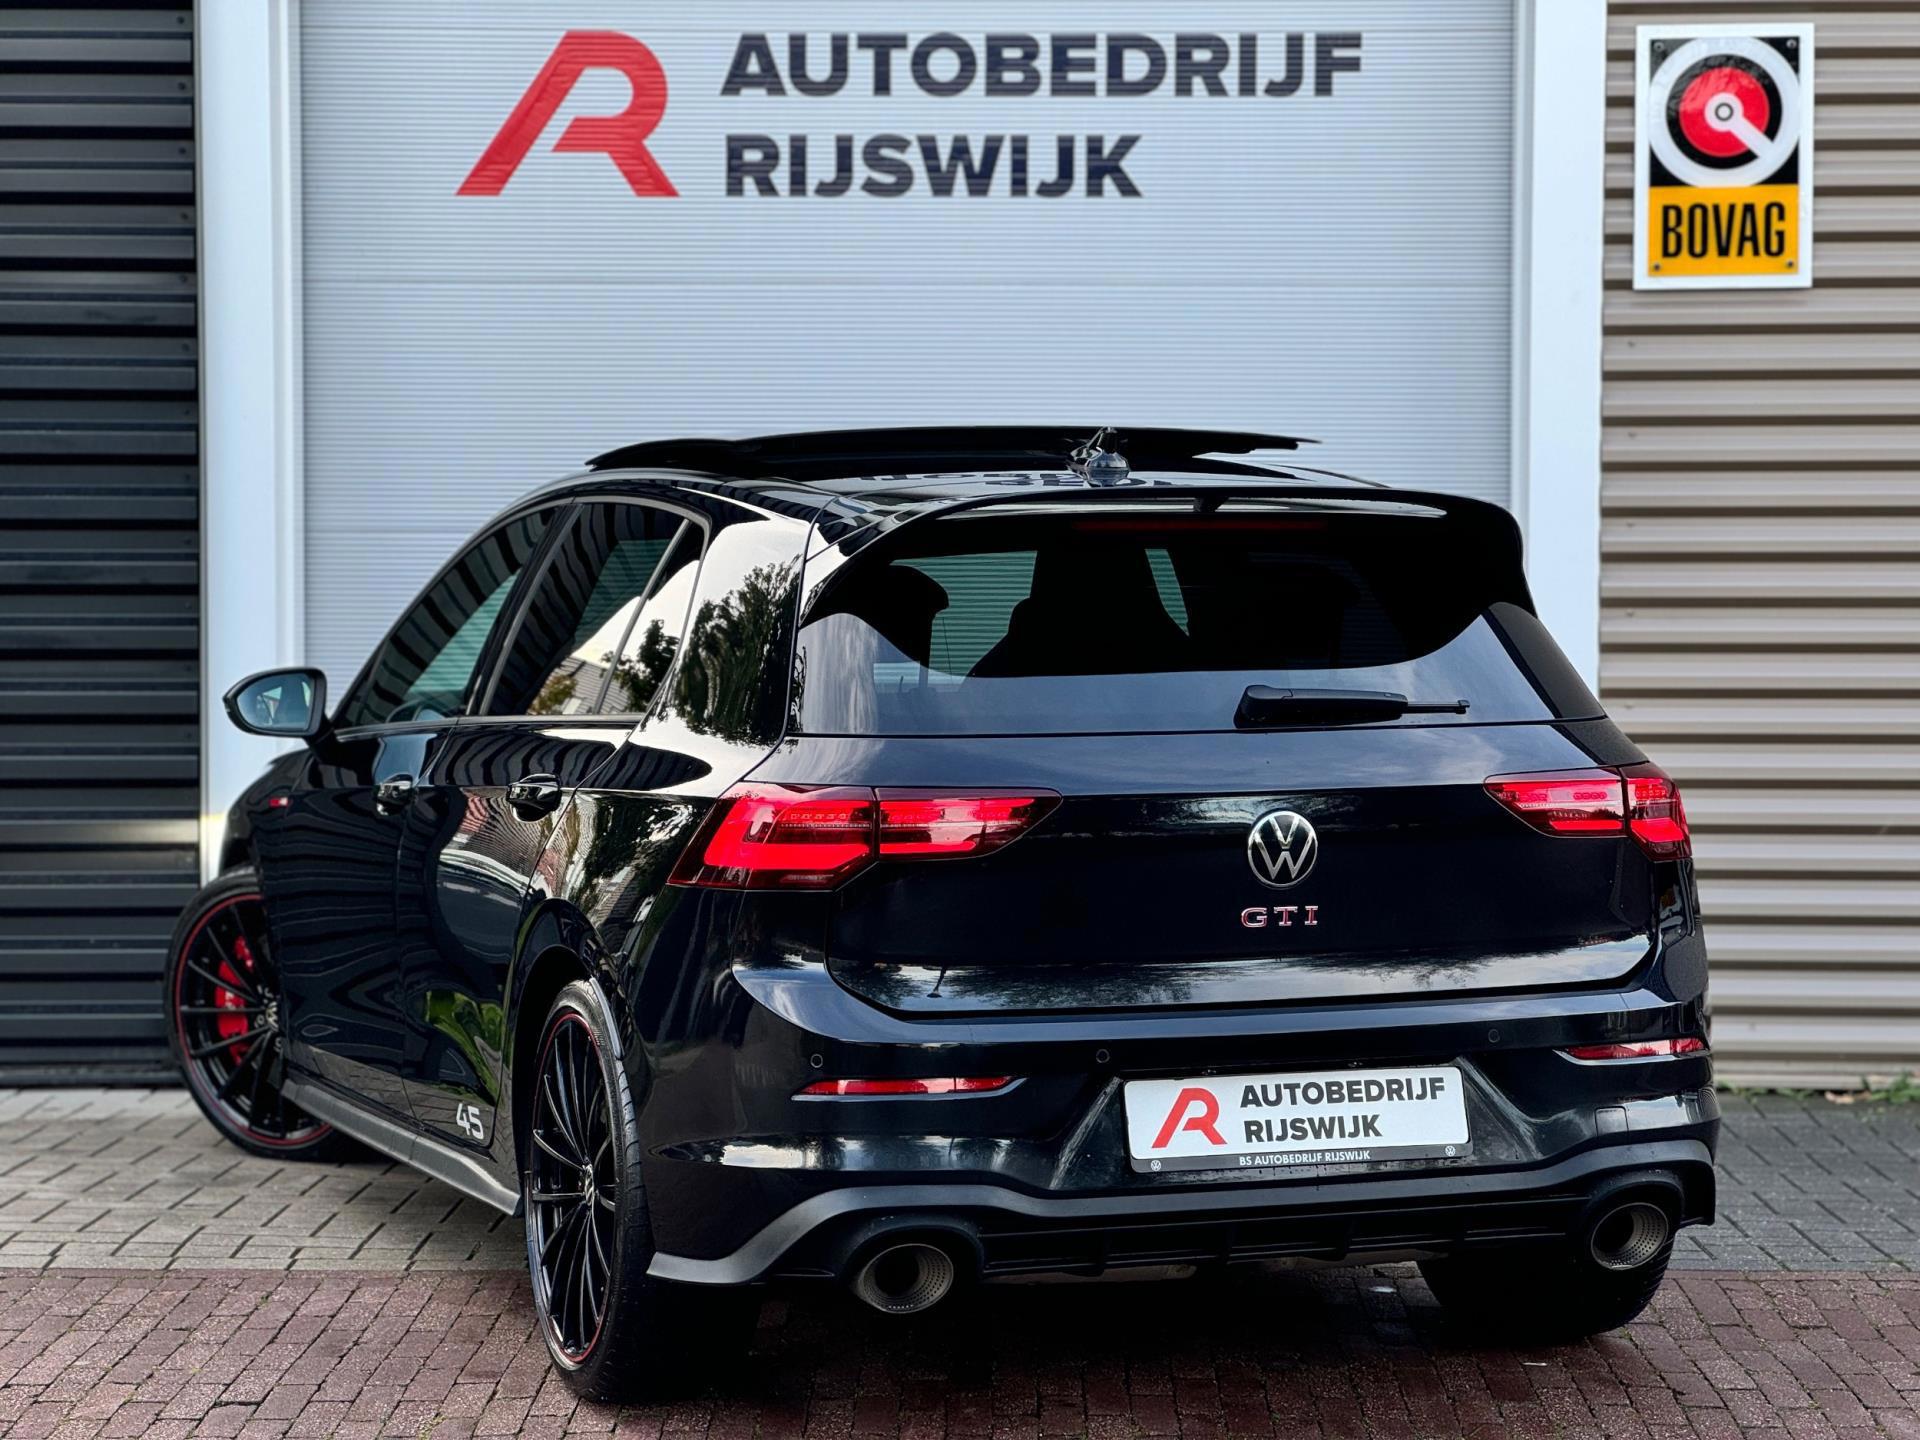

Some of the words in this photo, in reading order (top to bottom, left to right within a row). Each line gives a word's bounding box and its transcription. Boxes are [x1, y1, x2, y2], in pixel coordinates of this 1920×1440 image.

[719, 32, 1362, 98] AUTOBEDRIJF
[724, 132, 1144, 199] RIJSWIJK
[1661, 201, 1786, 259] BOVAG
[1240, 904, 1319, 929] GTI
[1240, 1076, 1446, 1109] AUTOBEDRIJF
[456, 1103, 484, 1140] 45
[1244, 1114, 1383, 1144] RIJSWIJK
[1239, 1156, 1252, 1166] BS
[1254, 1152, 1322, 1165] AUTOBEDRIJF
[1325, 1150, 1370, 1162] RIJSWIJK
